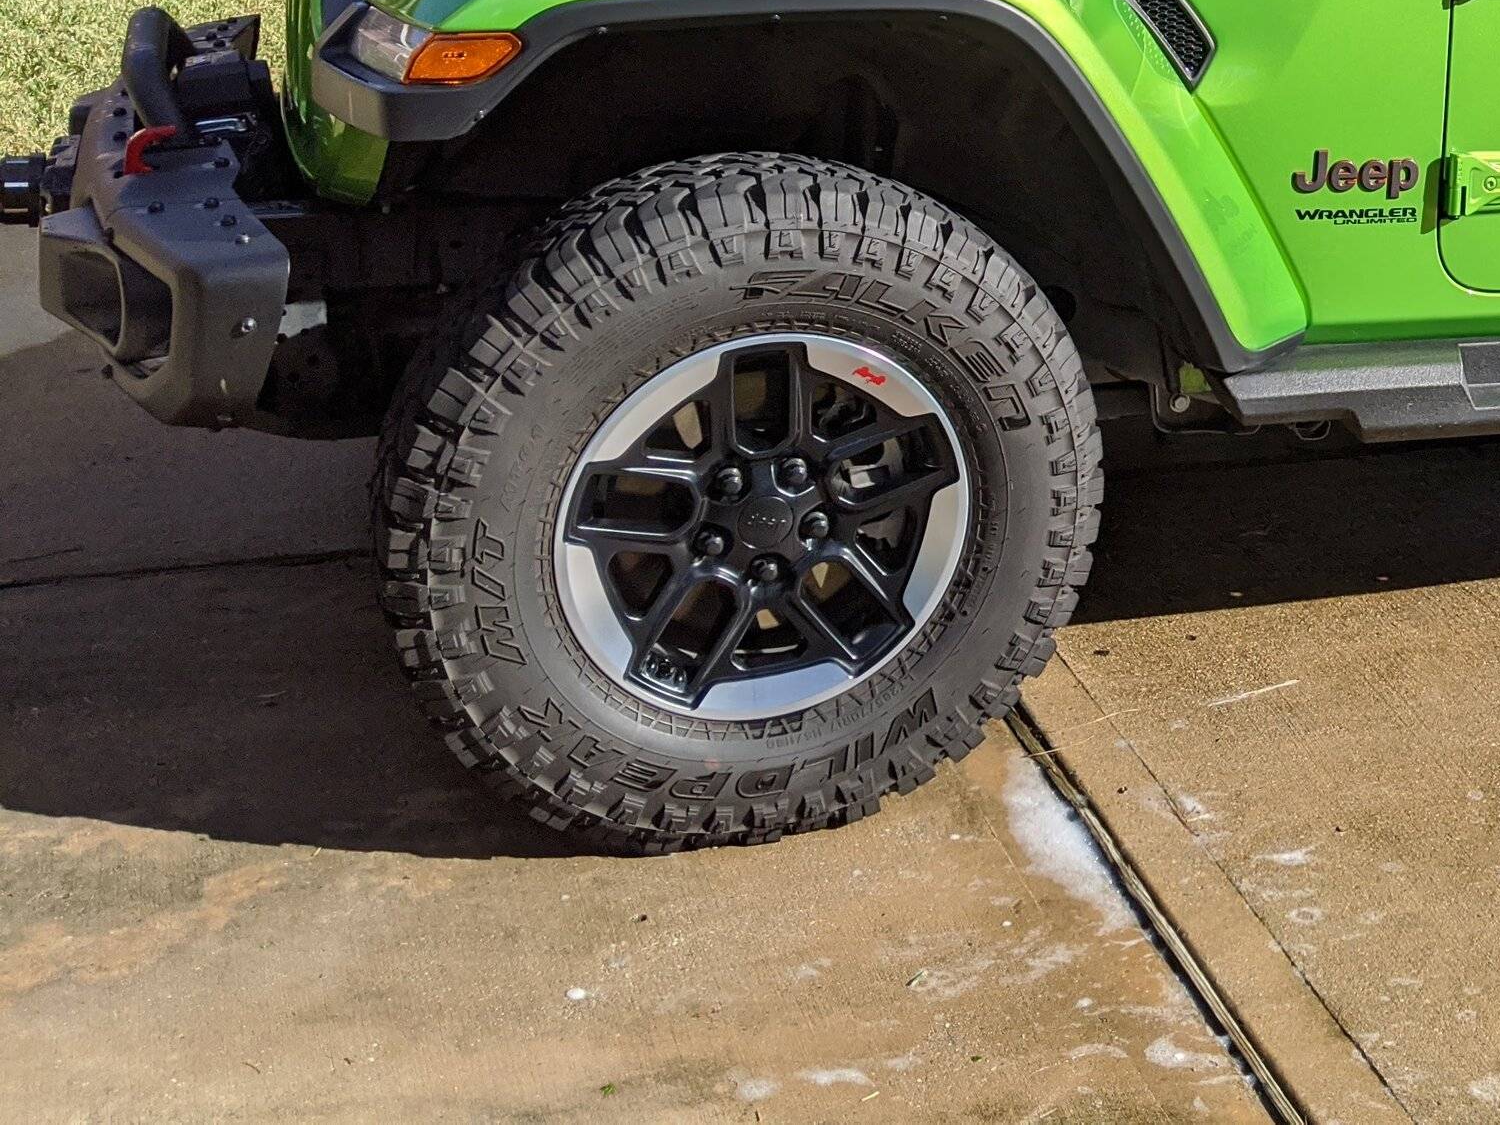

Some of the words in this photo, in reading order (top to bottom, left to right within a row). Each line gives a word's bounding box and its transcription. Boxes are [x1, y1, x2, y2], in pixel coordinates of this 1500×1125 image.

[1291, 149, 1420, 200] Jeep
[1295, 207, 1418, 221] WRANGLER
[1333, 217, 1418, 226] UNLIMITED
[728, 269, 1031, 431] FALKEN
[472, 517, 528, 666] M/T
[518, 687, 940, 801] WILDPEAK
